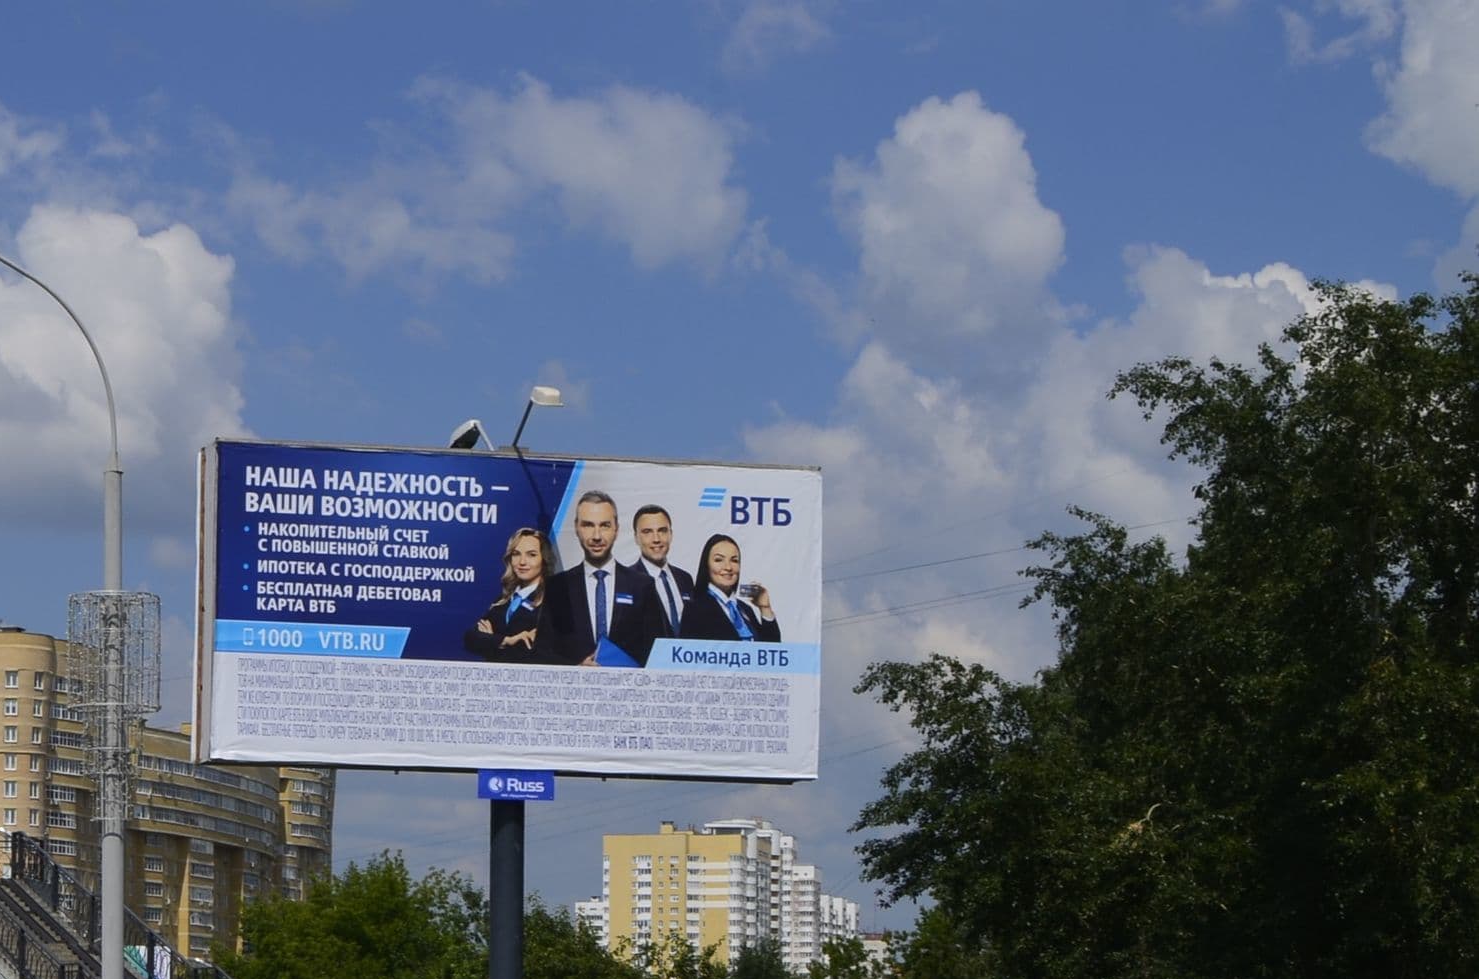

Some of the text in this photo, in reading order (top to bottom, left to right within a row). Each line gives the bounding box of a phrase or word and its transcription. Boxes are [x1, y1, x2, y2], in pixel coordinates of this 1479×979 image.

[245, 465, 317, 489] НАША
[323, 469, 484, 497] НАДЕЖНОСТЬ
[245, 492, 498, 524] ВАШИ ВОЗМОЖНОСТИ
[730, 496, 792, 526] ВТБ
[258, 522, 429, 543] НАКОПИТЕЛЬНЫЙ СЧЕТ
[258, 538, 449, 560] С ПОВЫШЕННОЙ СТАВКОЙ
[257, 560, 475, 583] ИПОТЕКА С ГОСПОДДЕРЖКОЙ
[257, 581, 442, 602] БЕСПЛАТНАЯ ДЕБЕТОВАЯ
[256, 597, 336, 613] КАРТА ВТБ
[257, 628, 385, 651] 1000 VTB.RU
[672, 646, 789, 667] Команда ВТБ
[506, 777, 545, 793] Russ
